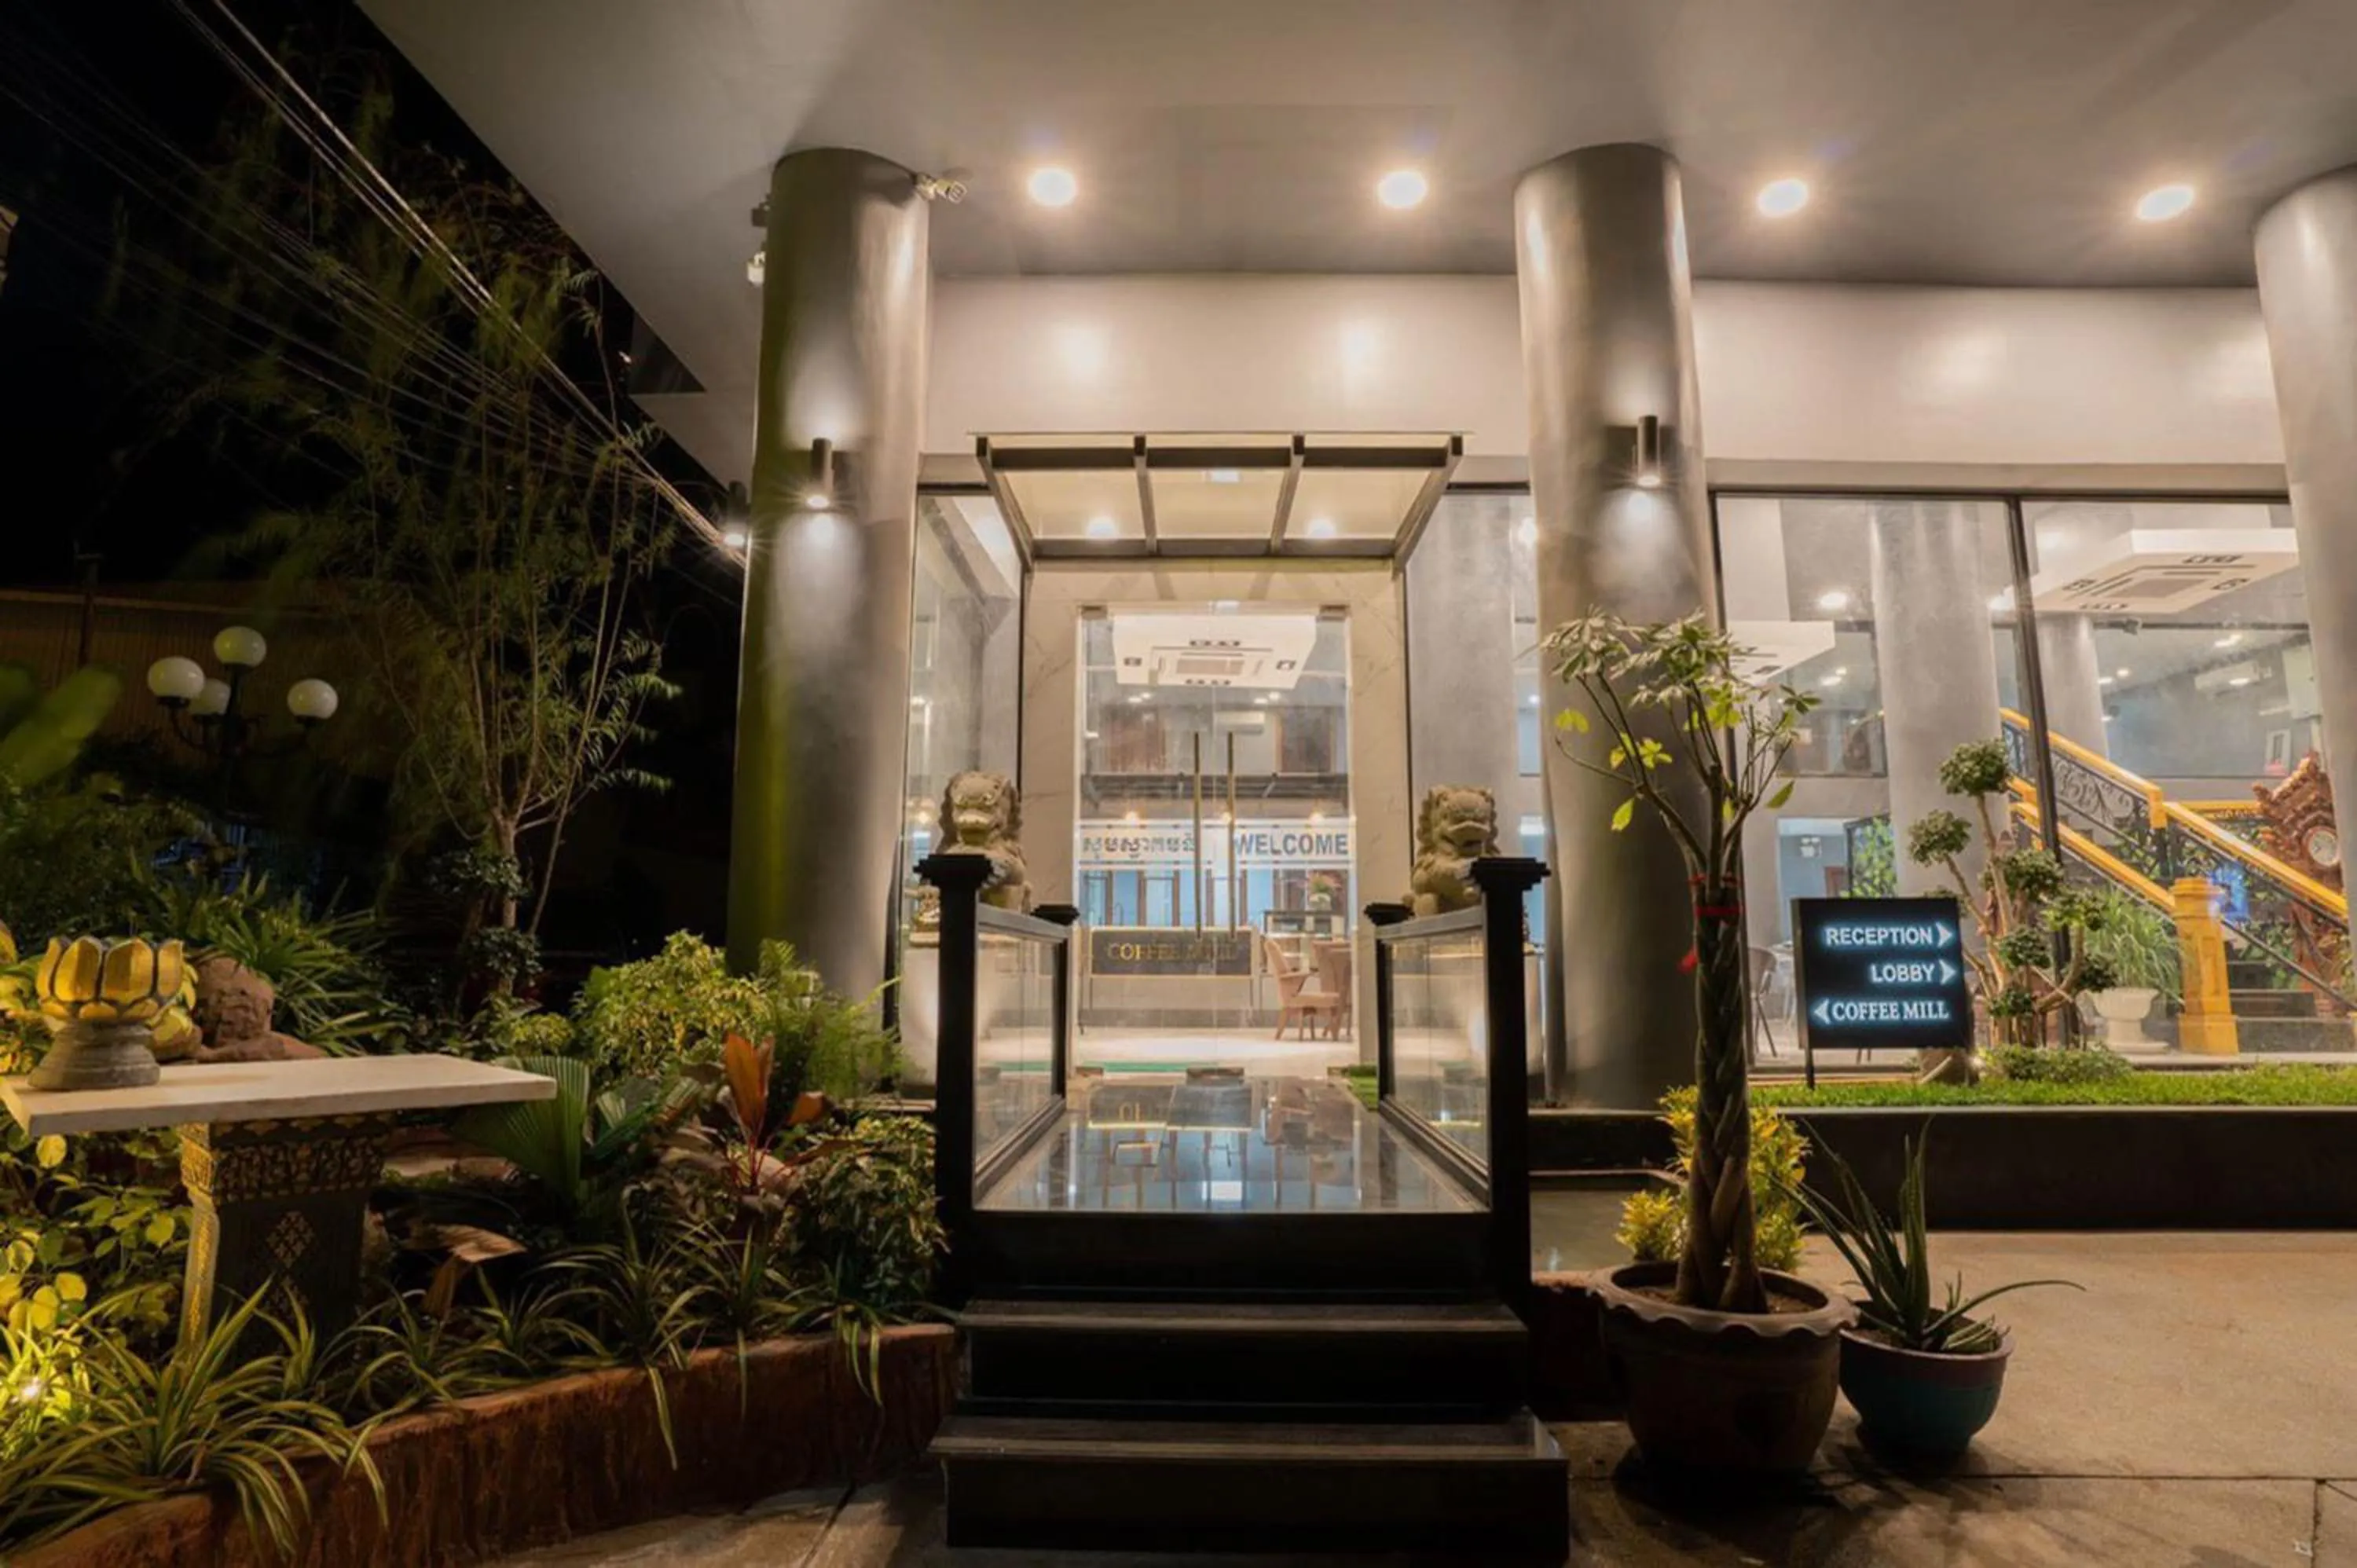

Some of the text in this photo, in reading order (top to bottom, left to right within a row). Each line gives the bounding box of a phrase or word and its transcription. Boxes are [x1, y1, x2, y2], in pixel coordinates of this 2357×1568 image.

[1234, 833, 1348, 855] WELCOME
[1825, 927, 1933, 946] RECEPTION
[1870, 963, 1935, 983] LOBBY
[1831, 1000, 1950, 1020] COFFEE MILL
